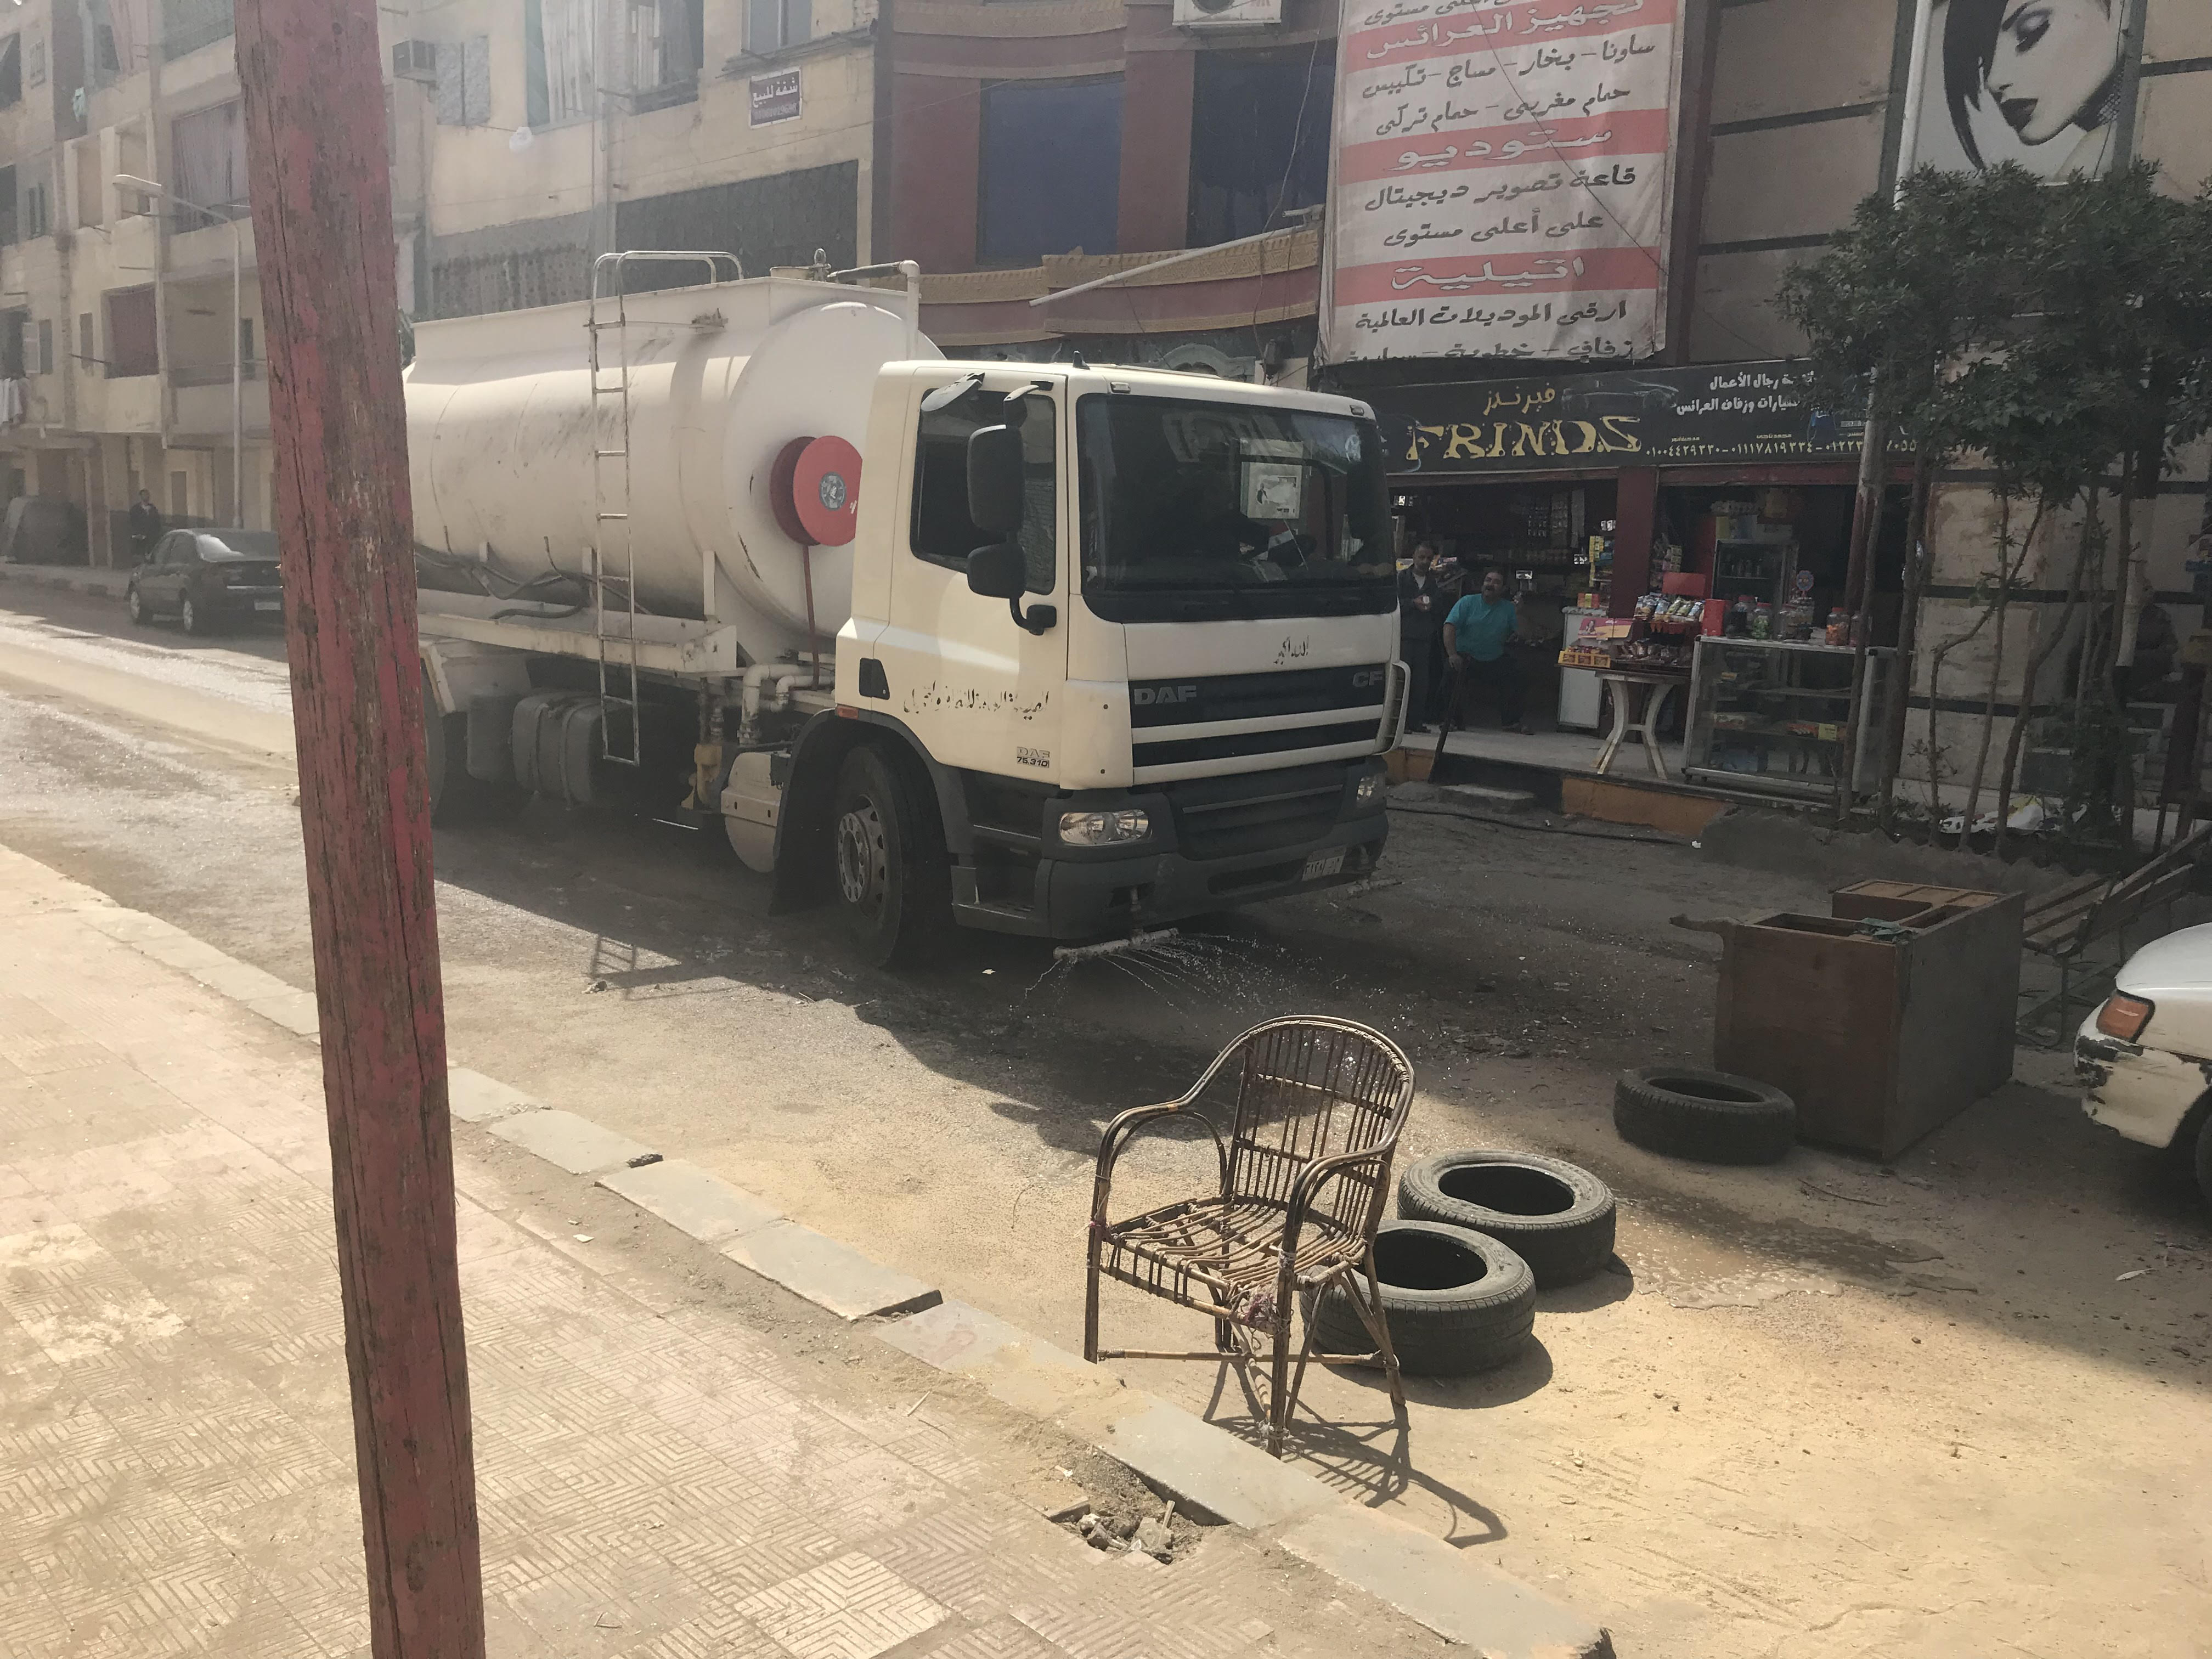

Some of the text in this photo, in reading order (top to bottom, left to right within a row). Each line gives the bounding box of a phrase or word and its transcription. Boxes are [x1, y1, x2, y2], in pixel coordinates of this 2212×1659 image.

[1364, 4, 1430, 25] مستوى
[1367, 10, 1513, 59] العرائس
[1601, 34, 1655, 62] ساونا
[1519, 48, 1575, 76] بخار
[1447, 59, 1495, 88] مساج
[1582, 82, 1630, 116] حمام
[1430, 103, 1478, 132] حمام
[1364, 165, 1636, 211] قاعة تصوير ديجيتال
[1384, 223, 1463, 247] مستوى
[1709, 371, 1751, 391] الأعمال
[1753, 373, 1779, 390] رجال
[1677, 397, 1719, 415] العرائس
[1721, 397, 1755, 414] وزفاف
[1406, 416, 1641, 460] FRINDS
[1352, 670, 1384, 688] CF
[1134, 685, 1197, 706] DAF
[1017, 746, 1050, 759] DAF
[1017, 756, 1049, 768] 75.310
